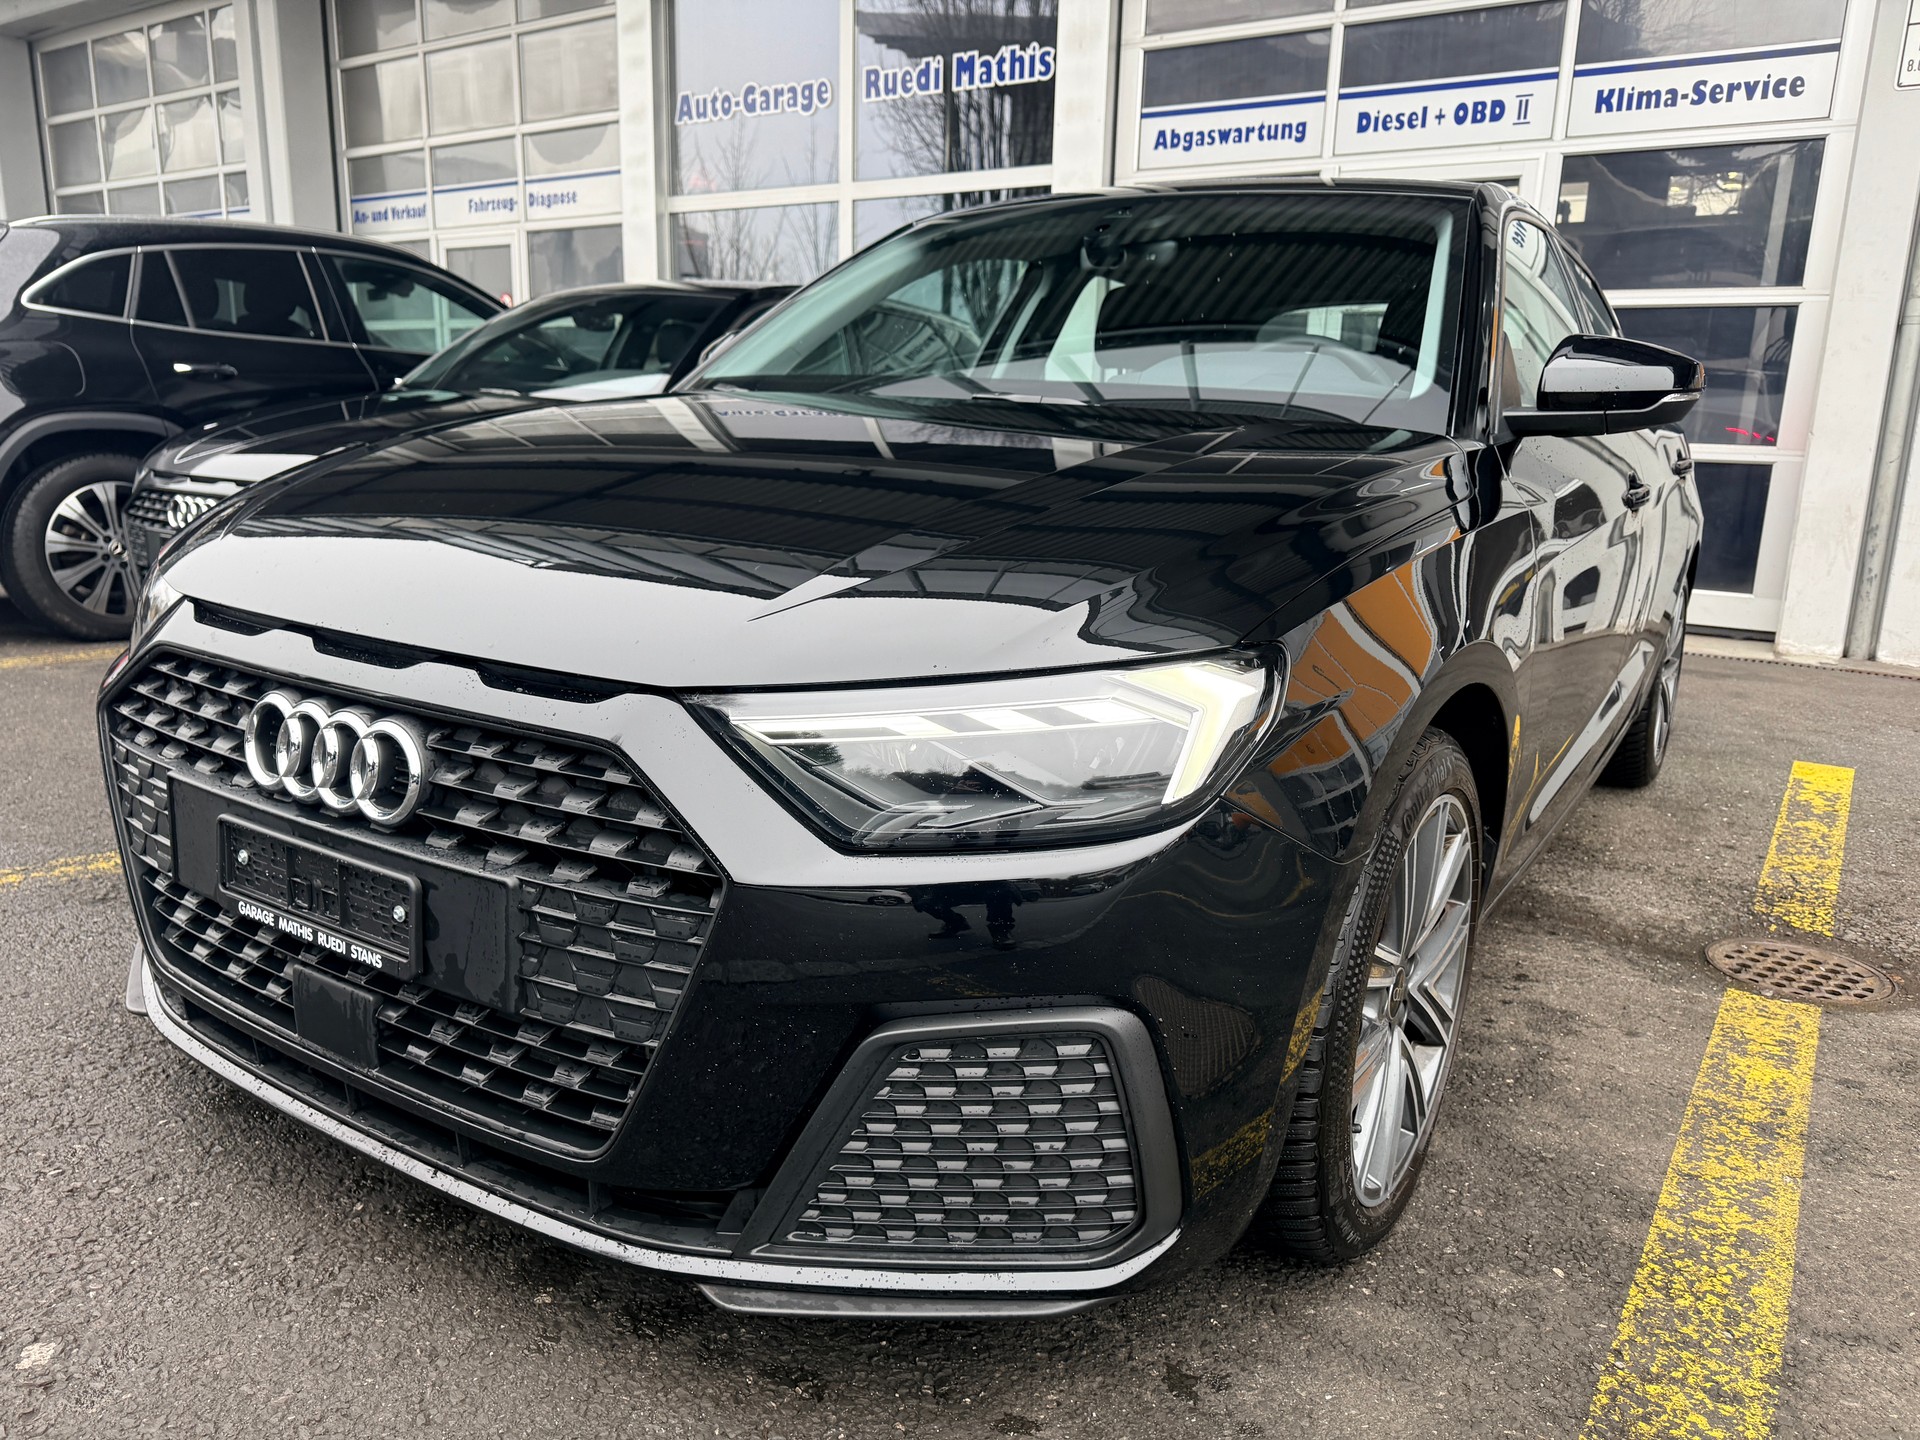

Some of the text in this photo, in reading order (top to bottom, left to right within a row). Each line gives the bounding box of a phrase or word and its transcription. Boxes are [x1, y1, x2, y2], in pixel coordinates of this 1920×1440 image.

[675, 43, 1055, 123] Auto-Garage Ruedi Mathis
[1594, 73, 1806, 114] Klima-Service
[1356, 93, 1534, 133] Diesel + OBD II
[1153, 120, 1308, 152] Abgaswartung
[354, 203, 427, 225] An- und Verkauf
[468, 190, 578, 214] Fahrzeug- Diagnose
[237, 900, 383, 969] GARAGE MATHIS RUEDI STANS
